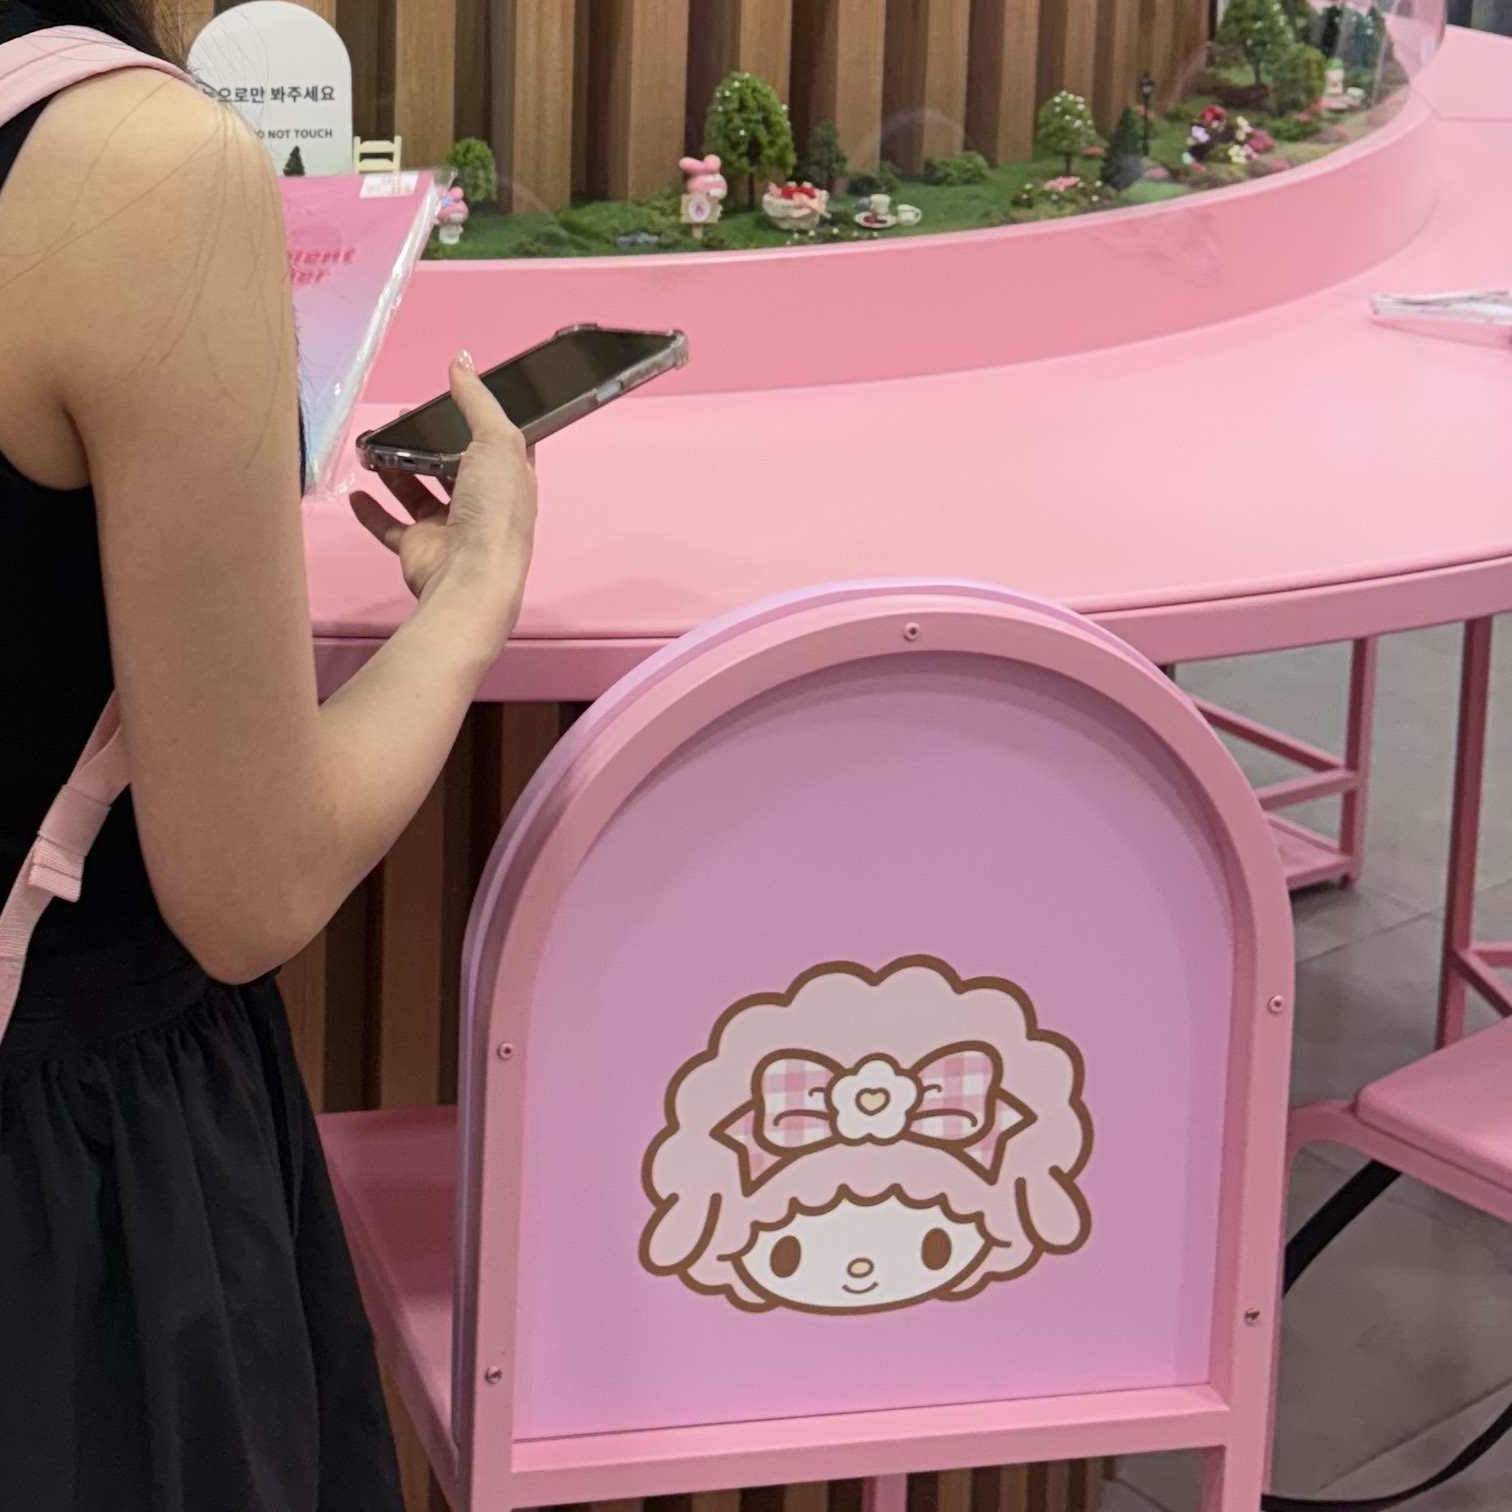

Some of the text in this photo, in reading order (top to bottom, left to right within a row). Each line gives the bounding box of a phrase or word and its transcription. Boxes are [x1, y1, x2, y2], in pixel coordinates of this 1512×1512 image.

[270, 85, 335, 103] 봐주세요
[268, 129, 291, 139] NOT
[294, 128, 333, 139] TOUCH
